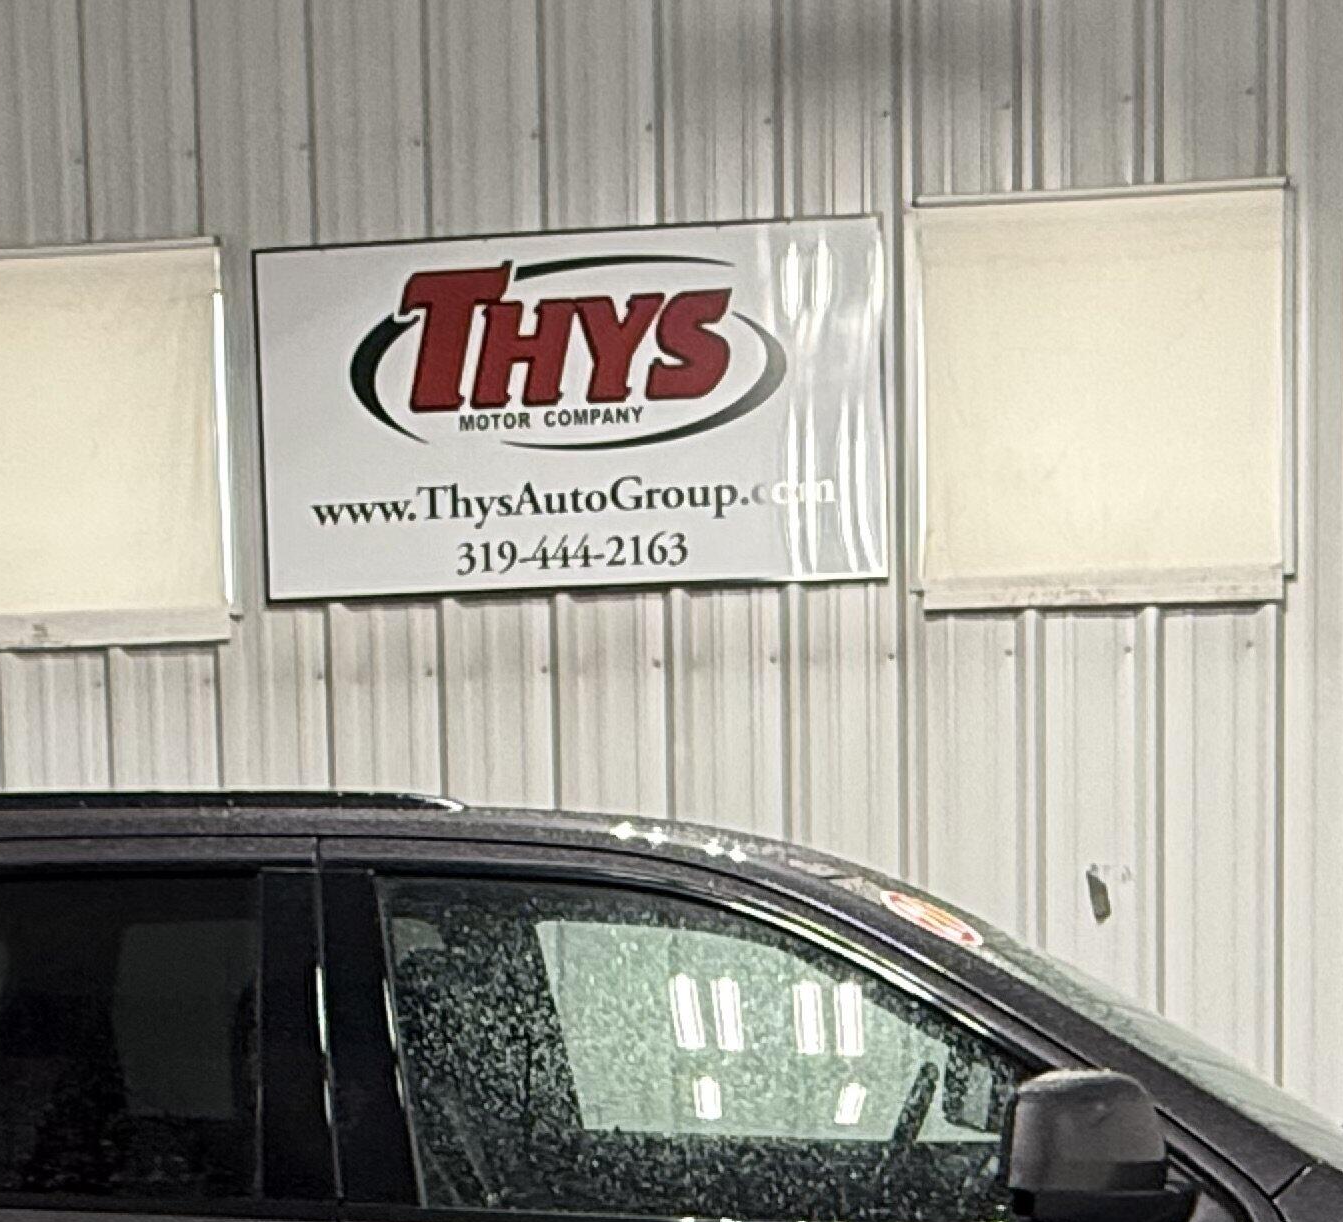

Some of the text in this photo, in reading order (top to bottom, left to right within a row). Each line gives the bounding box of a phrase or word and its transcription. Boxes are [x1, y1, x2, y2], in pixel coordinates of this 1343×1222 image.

[399, 260, 732, 412] THYS
[459, 406, 644, 432] MOTOR COMPANY
[457, 532, 689, 576] 319-444-2163
